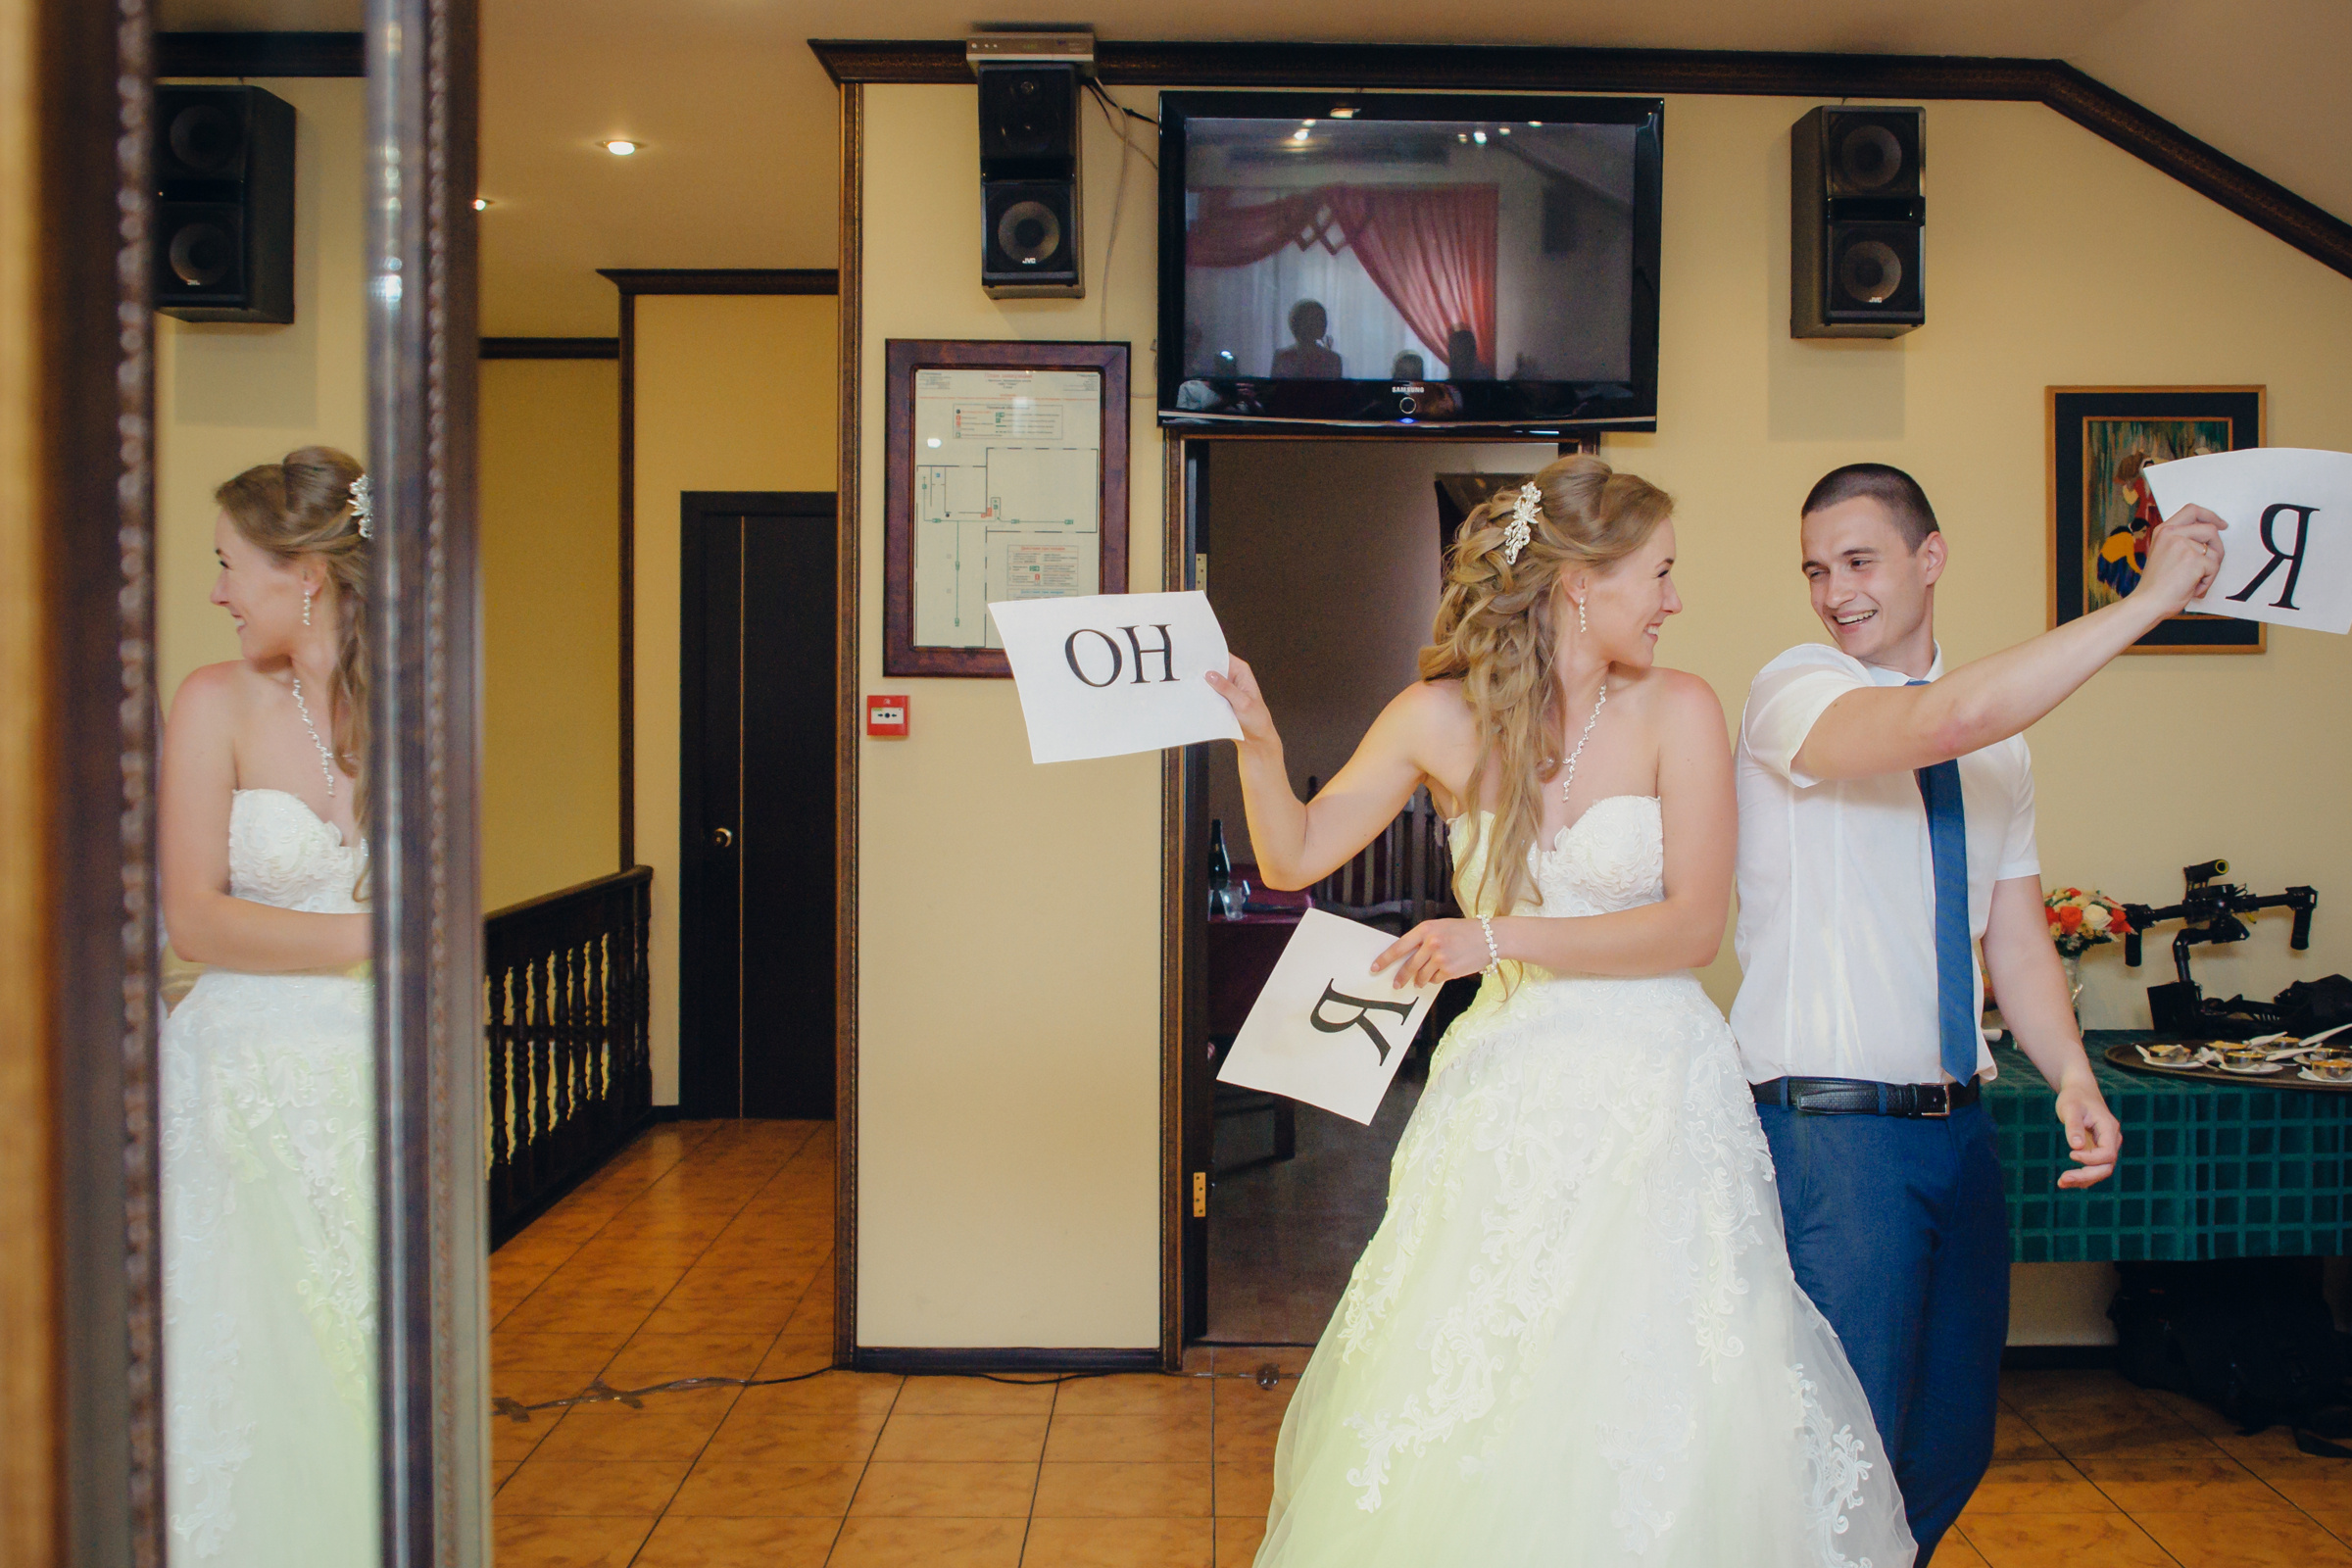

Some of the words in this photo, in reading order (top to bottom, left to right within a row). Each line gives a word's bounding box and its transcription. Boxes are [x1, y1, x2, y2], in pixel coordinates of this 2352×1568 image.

[2225, 503, 2321, 611] Я
[1064, 623, 1181, 688] ОН
[1310, 978, 1419, 1066] Я
